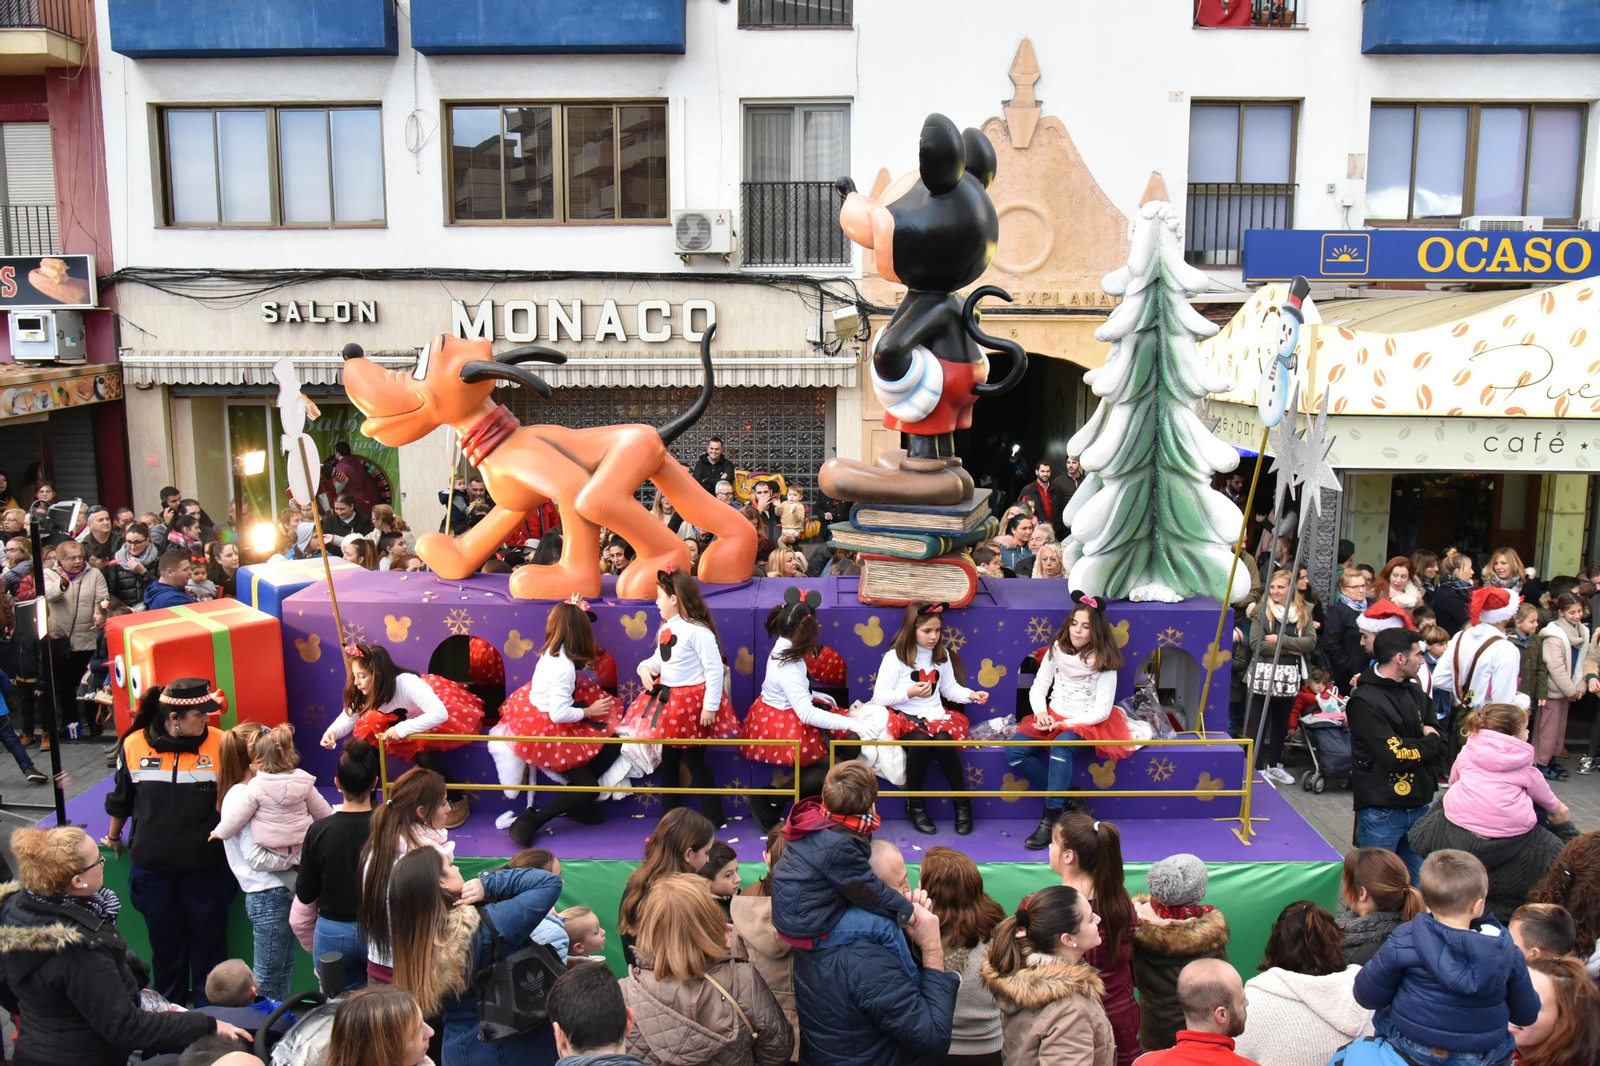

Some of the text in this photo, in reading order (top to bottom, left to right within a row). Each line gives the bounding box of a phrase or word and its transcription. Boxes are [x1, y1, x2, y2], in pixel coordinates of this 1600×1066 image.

[1417, 236, 1592, 274] OCASO
[0, 266, 18, 298] S
[260, 300, 378, 323] SALON
[1012, 292, 1124, 306] EXPLANAD
[450, 299, 717, 343] MONACO
[1468, 343, 1600, 402] Pue
[1483, 431, 1565, 454] café
